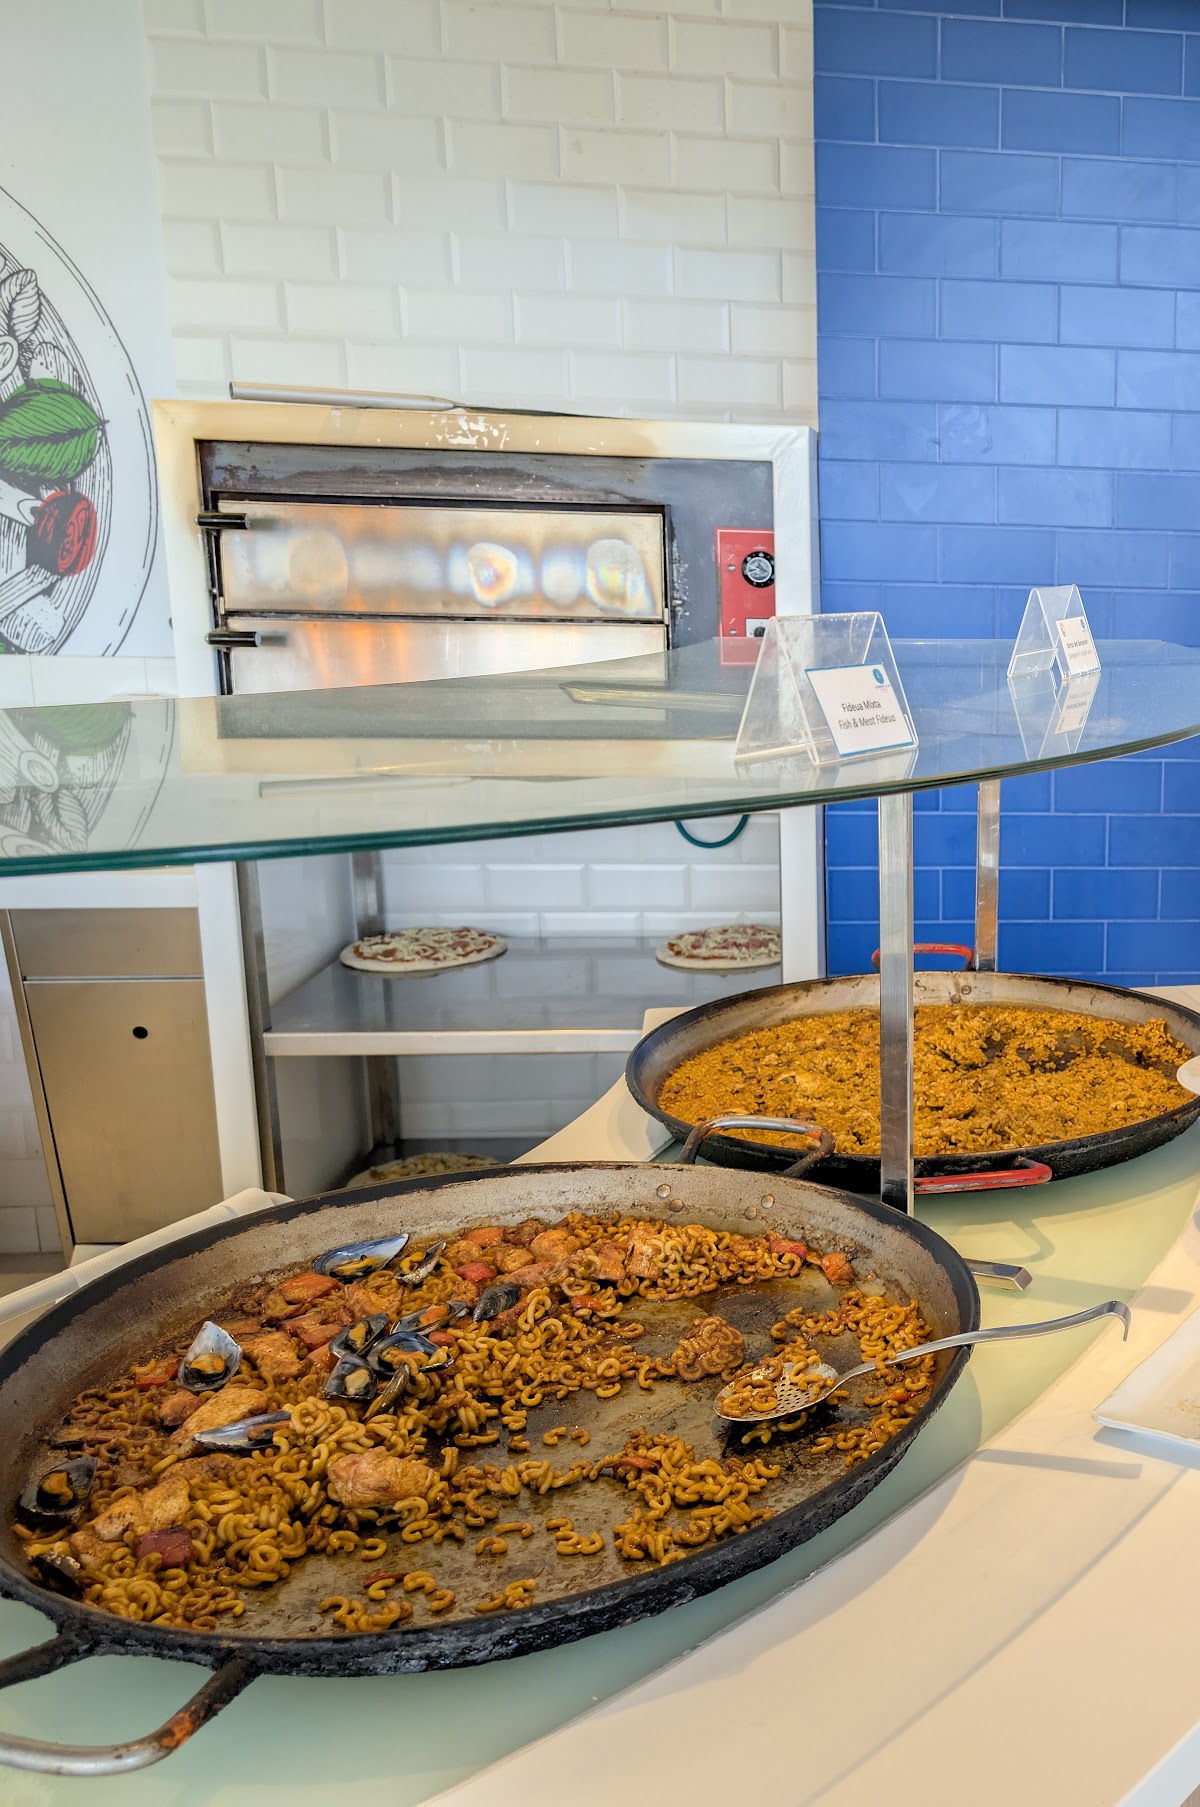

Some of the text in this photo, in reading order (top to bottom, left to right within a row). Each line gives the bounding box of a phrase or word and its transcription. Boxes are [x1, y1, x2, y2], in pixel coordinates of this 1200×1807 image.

[841, 700, 881, 712] Fideua Mixta
[838, 714, 896, 730] Fish & Meat Fideua
